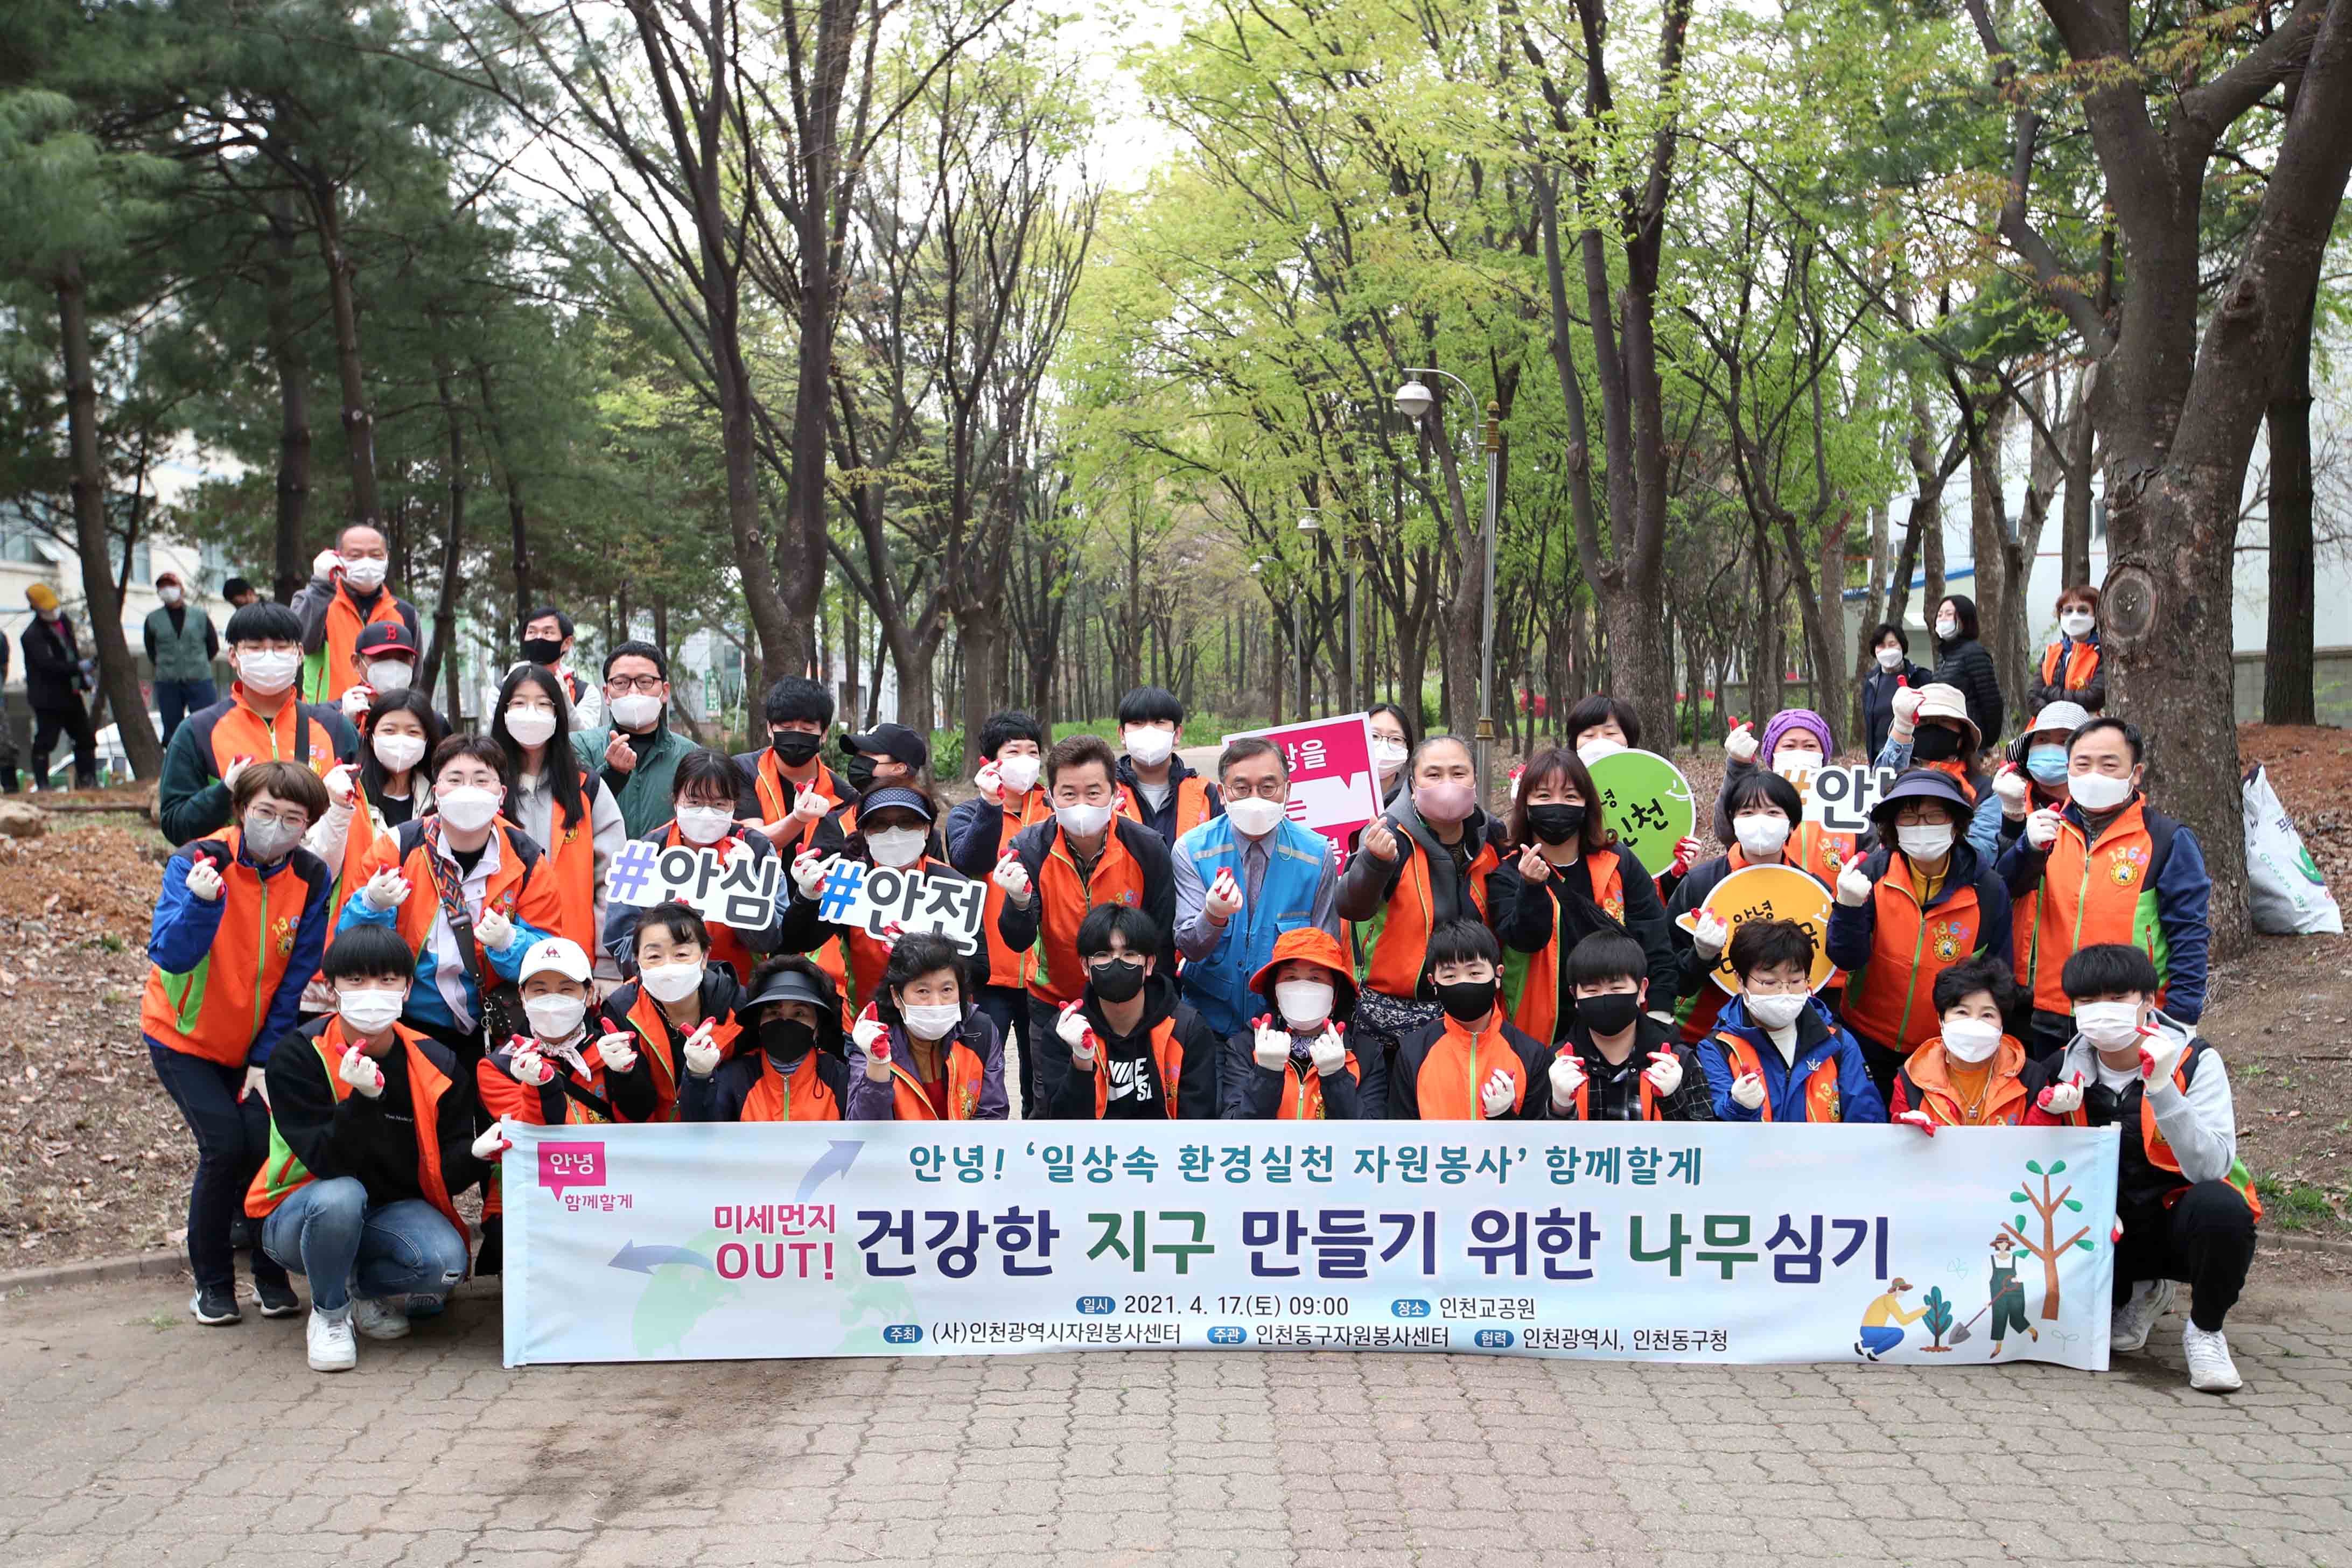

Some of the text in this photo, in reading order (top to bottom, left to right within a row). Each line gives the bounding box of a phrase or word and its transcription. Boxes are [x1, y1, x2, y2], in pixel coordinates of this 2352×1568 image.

[610, 844, 777, 926] #안심
[818, 852, 982, 951] #안전
[550, 1153, 594, 1174] 안녕
[909, 1144, 1005, 1182] 안녕!
[1178, 1144, 1333, 1183] 환경실천
[1545, 1145, 1702, 1186] 함께할게
[564, 1194, 633, 1211] 함께할게
[715, 1204, 836, 1236] 미세먼지
[717, 1242, 834, 1280] OUT!
[857, 1206, 1889, 1284] 건강한 지구 만들기 위한 나무심기
[1082, 1295, 1536, 1320] 일시 2021. 4. 17.(토) 09:00 장소 인천교공원
[890, 1322, 1728, 1352] 주최 (사)인천광역시자원봉사센터 주관 인천동구자원봉사센터 협력 인천광역시, 인천동구청
